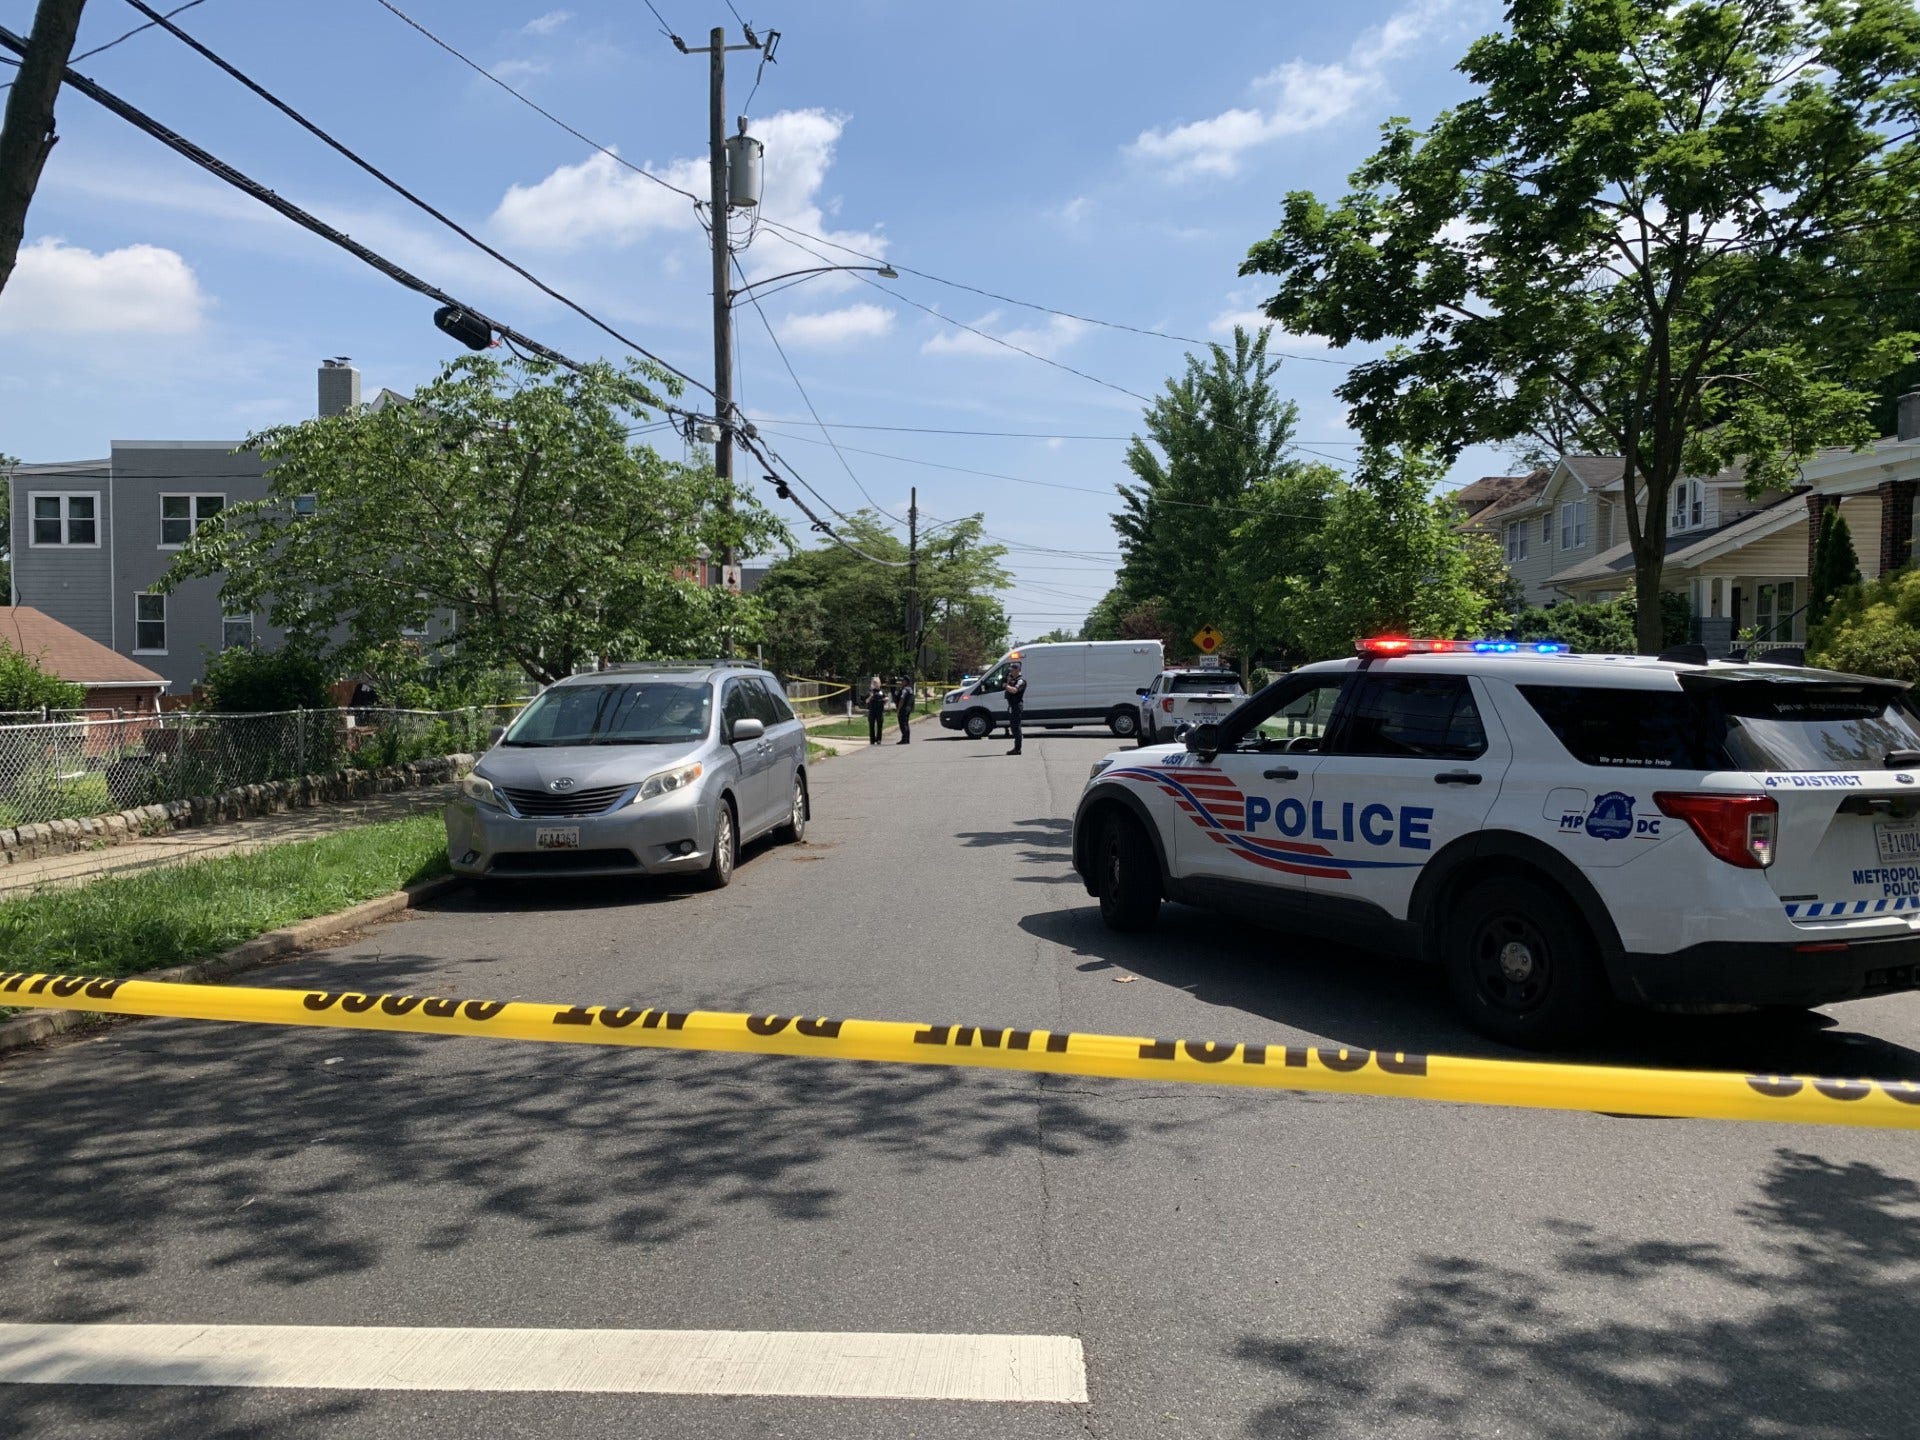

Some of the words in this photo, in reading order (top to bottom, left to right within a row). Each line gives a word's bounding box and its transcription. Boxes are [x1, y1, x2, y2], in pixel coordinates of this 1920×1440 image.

[1765, 776, 1790, 787] 4TH
[1791, 775, 1863, 787] DISTRICT
[1246, 796, 1434, 850] POLICE
[1561, 815, 1584, 828] MP
[1636, 819, 1661, 834] DC
[1883, 881, 1920, 896] POLIC
